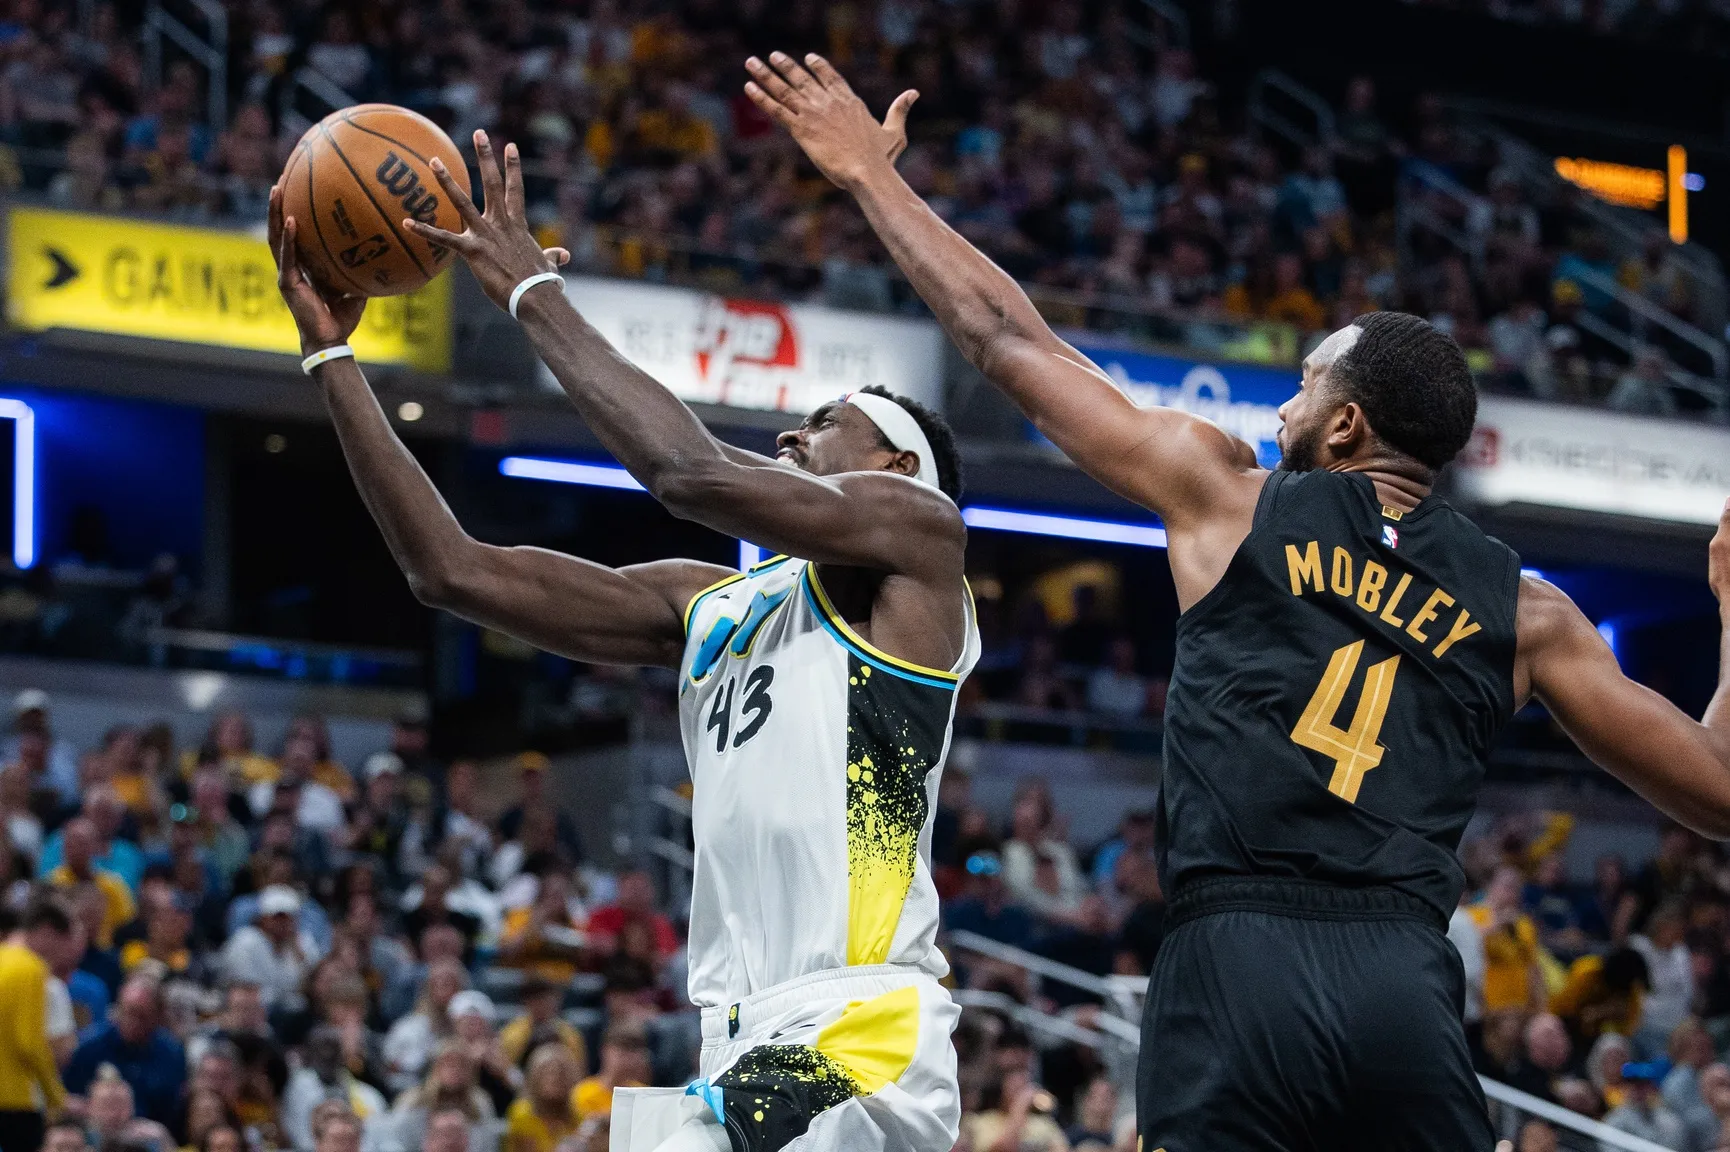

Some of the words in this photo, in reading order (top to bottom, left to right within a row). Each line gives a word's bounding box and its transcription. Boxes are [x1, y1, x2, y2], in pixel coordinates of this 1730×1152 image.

[1285, 541, 1482, 659] MOBLEY
[707, 664, 775, 755] 43
[1290, 639, 1402, 804] 4
